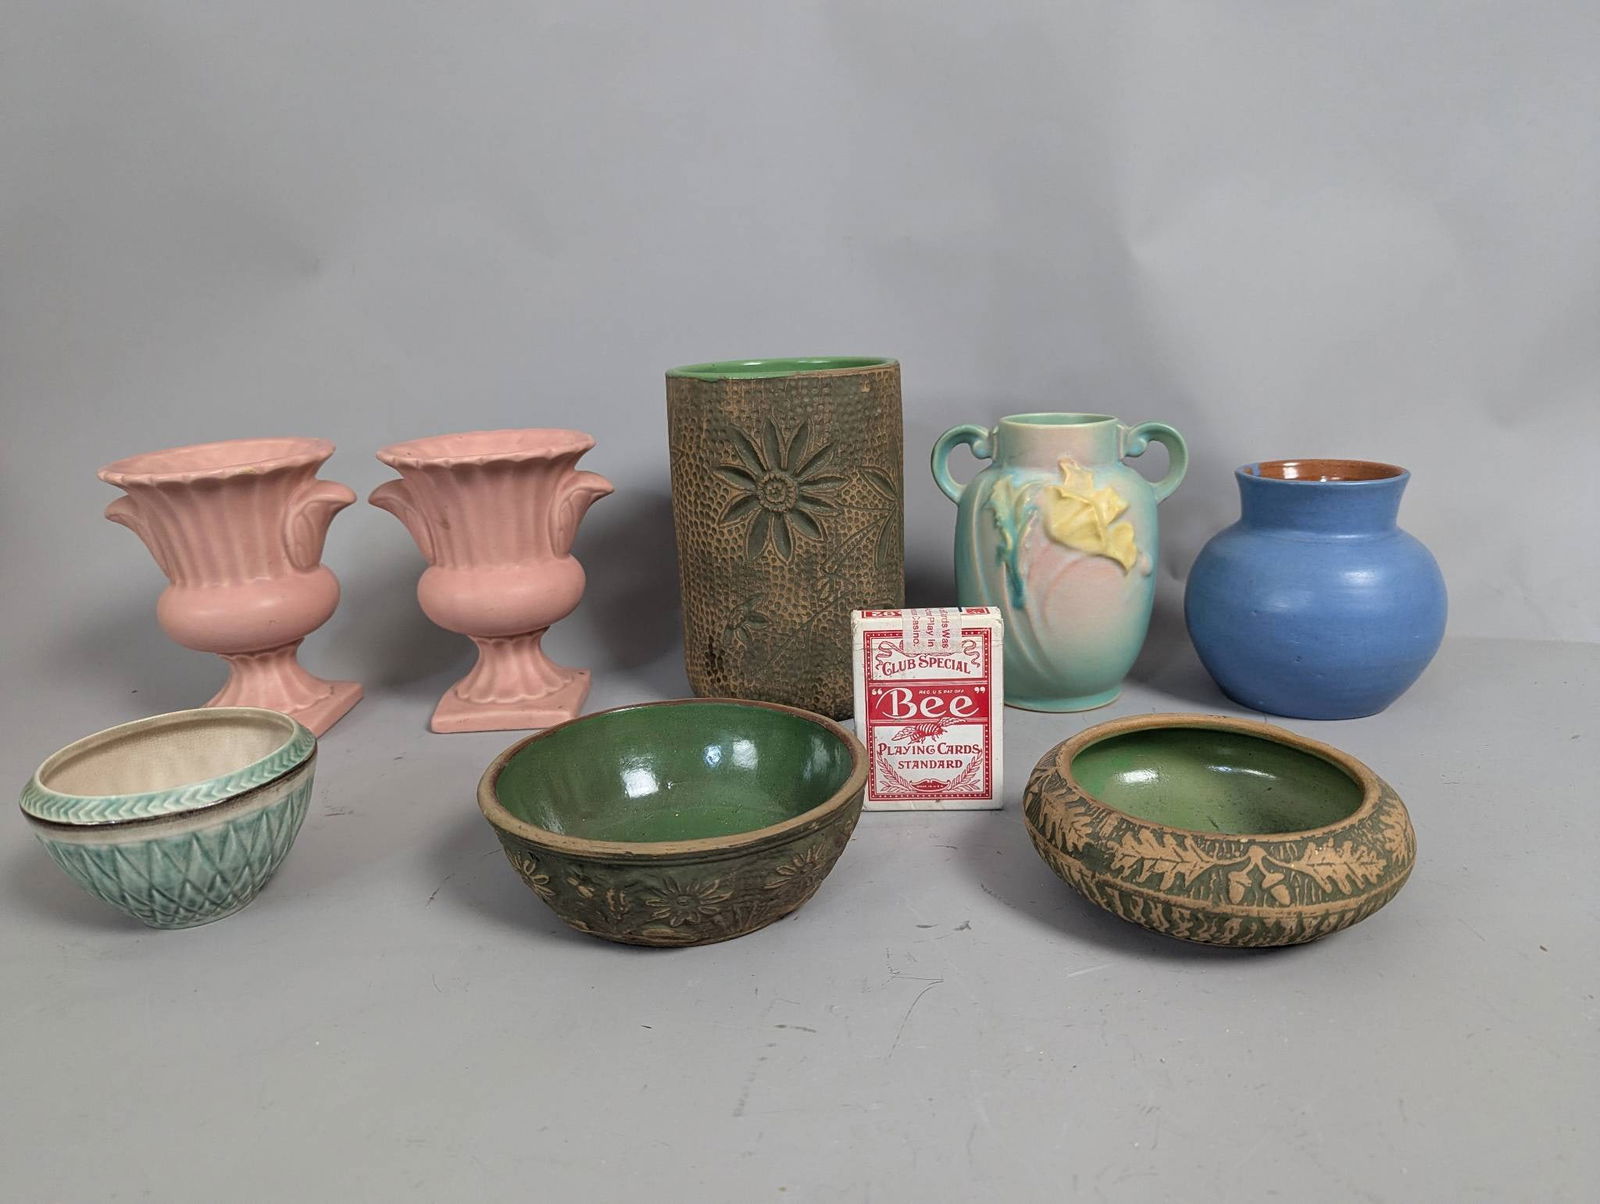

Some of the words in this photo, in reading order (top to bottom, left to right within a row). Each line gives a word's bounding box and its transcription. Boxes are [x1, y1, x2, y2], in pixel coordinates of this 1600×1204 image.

[926, 617, 934, 636] Play
[942, 629, 950, 649] Was
[882, 658, 916, 676] CLUB
[918, 656, 971, 674] SPECIAL
[878, 743, 935, 755] PLAYING
[937, 742, 981, 755] CARDS
[898, 759, 963, 769] STANDARD
